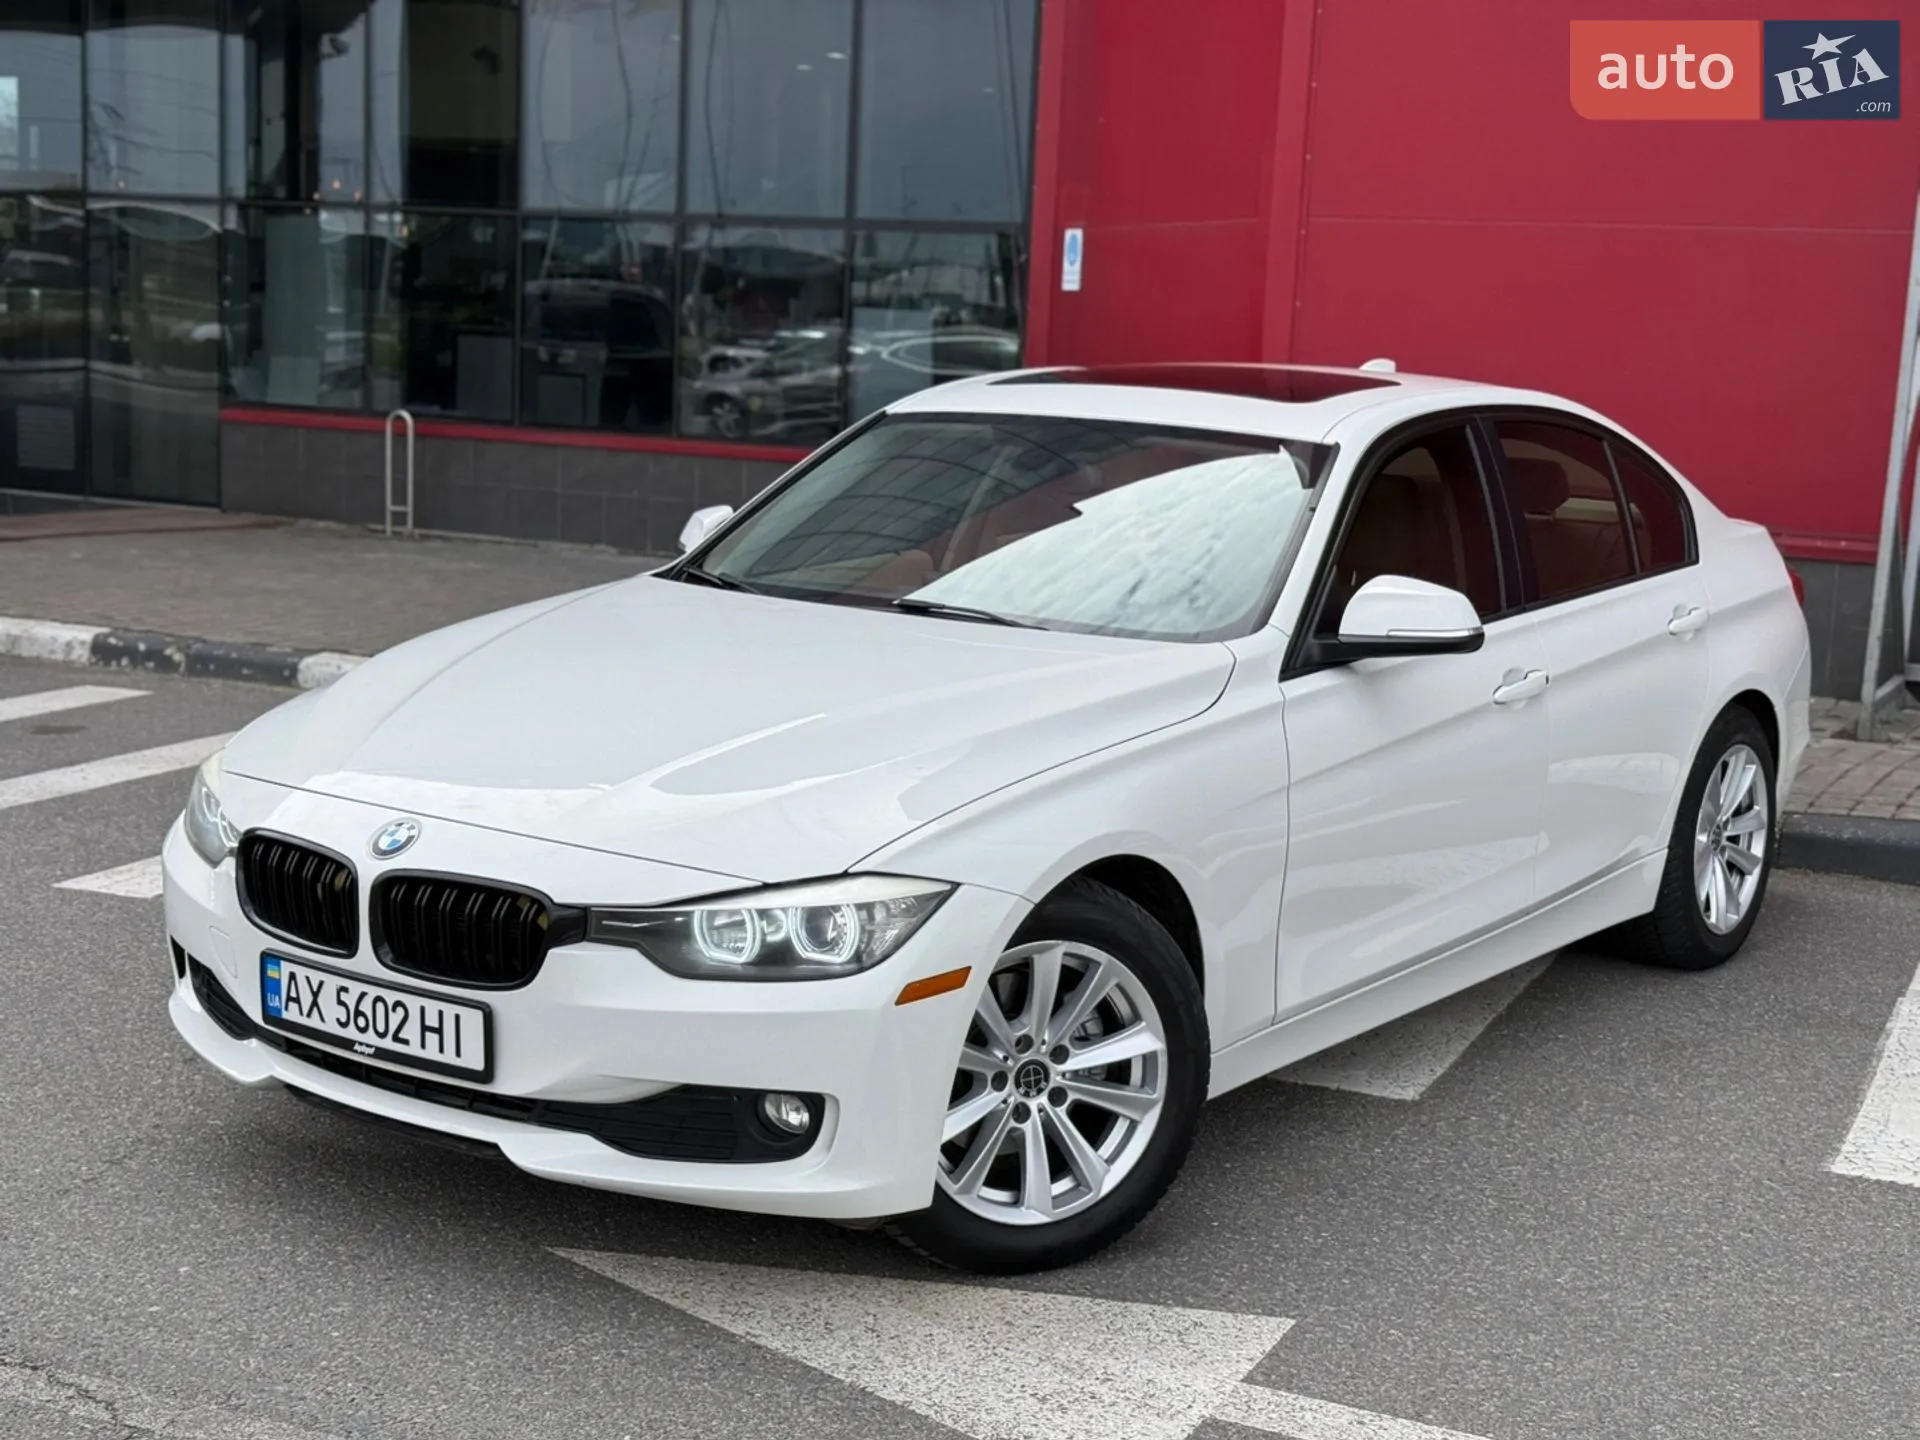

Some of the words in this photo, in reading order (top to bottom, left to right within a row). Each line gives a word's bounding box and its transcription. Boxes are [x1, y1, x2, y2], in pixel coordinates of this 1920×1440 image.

[267, 993, 281, 1008] UA
[285, 971, 325, 1023] AX
[336, 985, 410, 1046] 5602
[420, 1005, 461, 1058] HI
